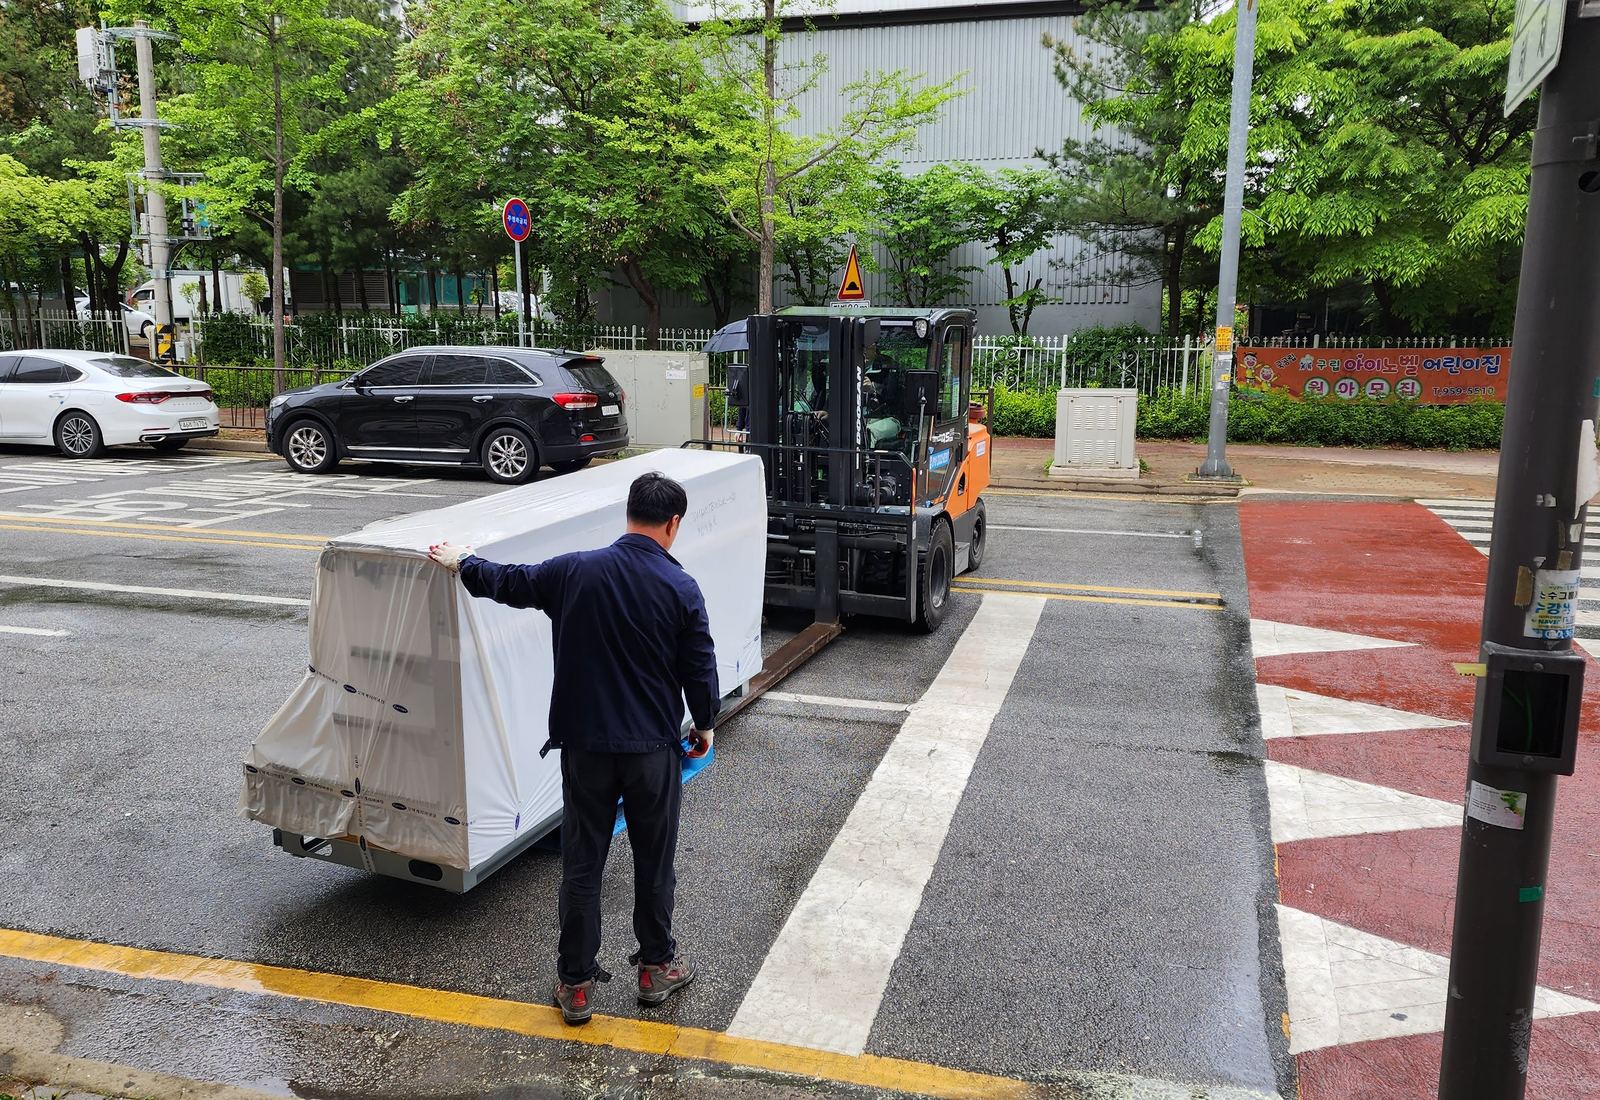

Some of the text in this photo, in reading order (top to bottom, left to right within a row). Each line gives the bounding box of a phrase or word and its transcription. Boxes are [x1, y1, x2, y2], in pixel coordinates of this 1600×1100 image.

[1317, 353, 1501, 376] 구립 아이노벨 어린이집
